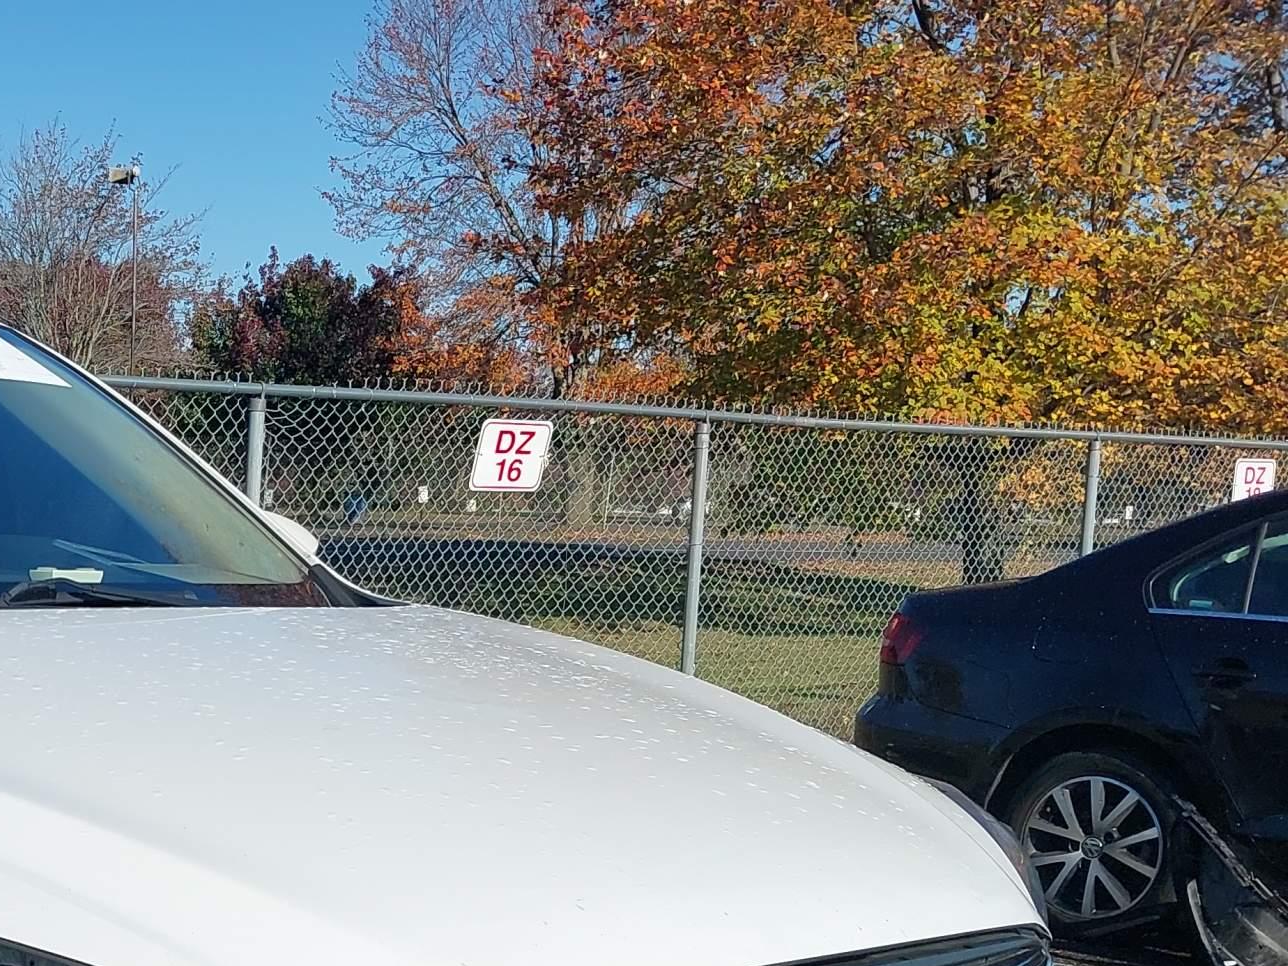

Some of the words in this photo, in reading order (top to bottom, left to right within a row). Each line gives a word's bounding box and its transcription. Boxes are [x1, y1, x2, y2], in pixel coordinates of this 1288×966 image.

[495, 430, 536, 454] DZ
[496, 459, 523, 482] 16
[1244, 466, 1266, 485] DZ
